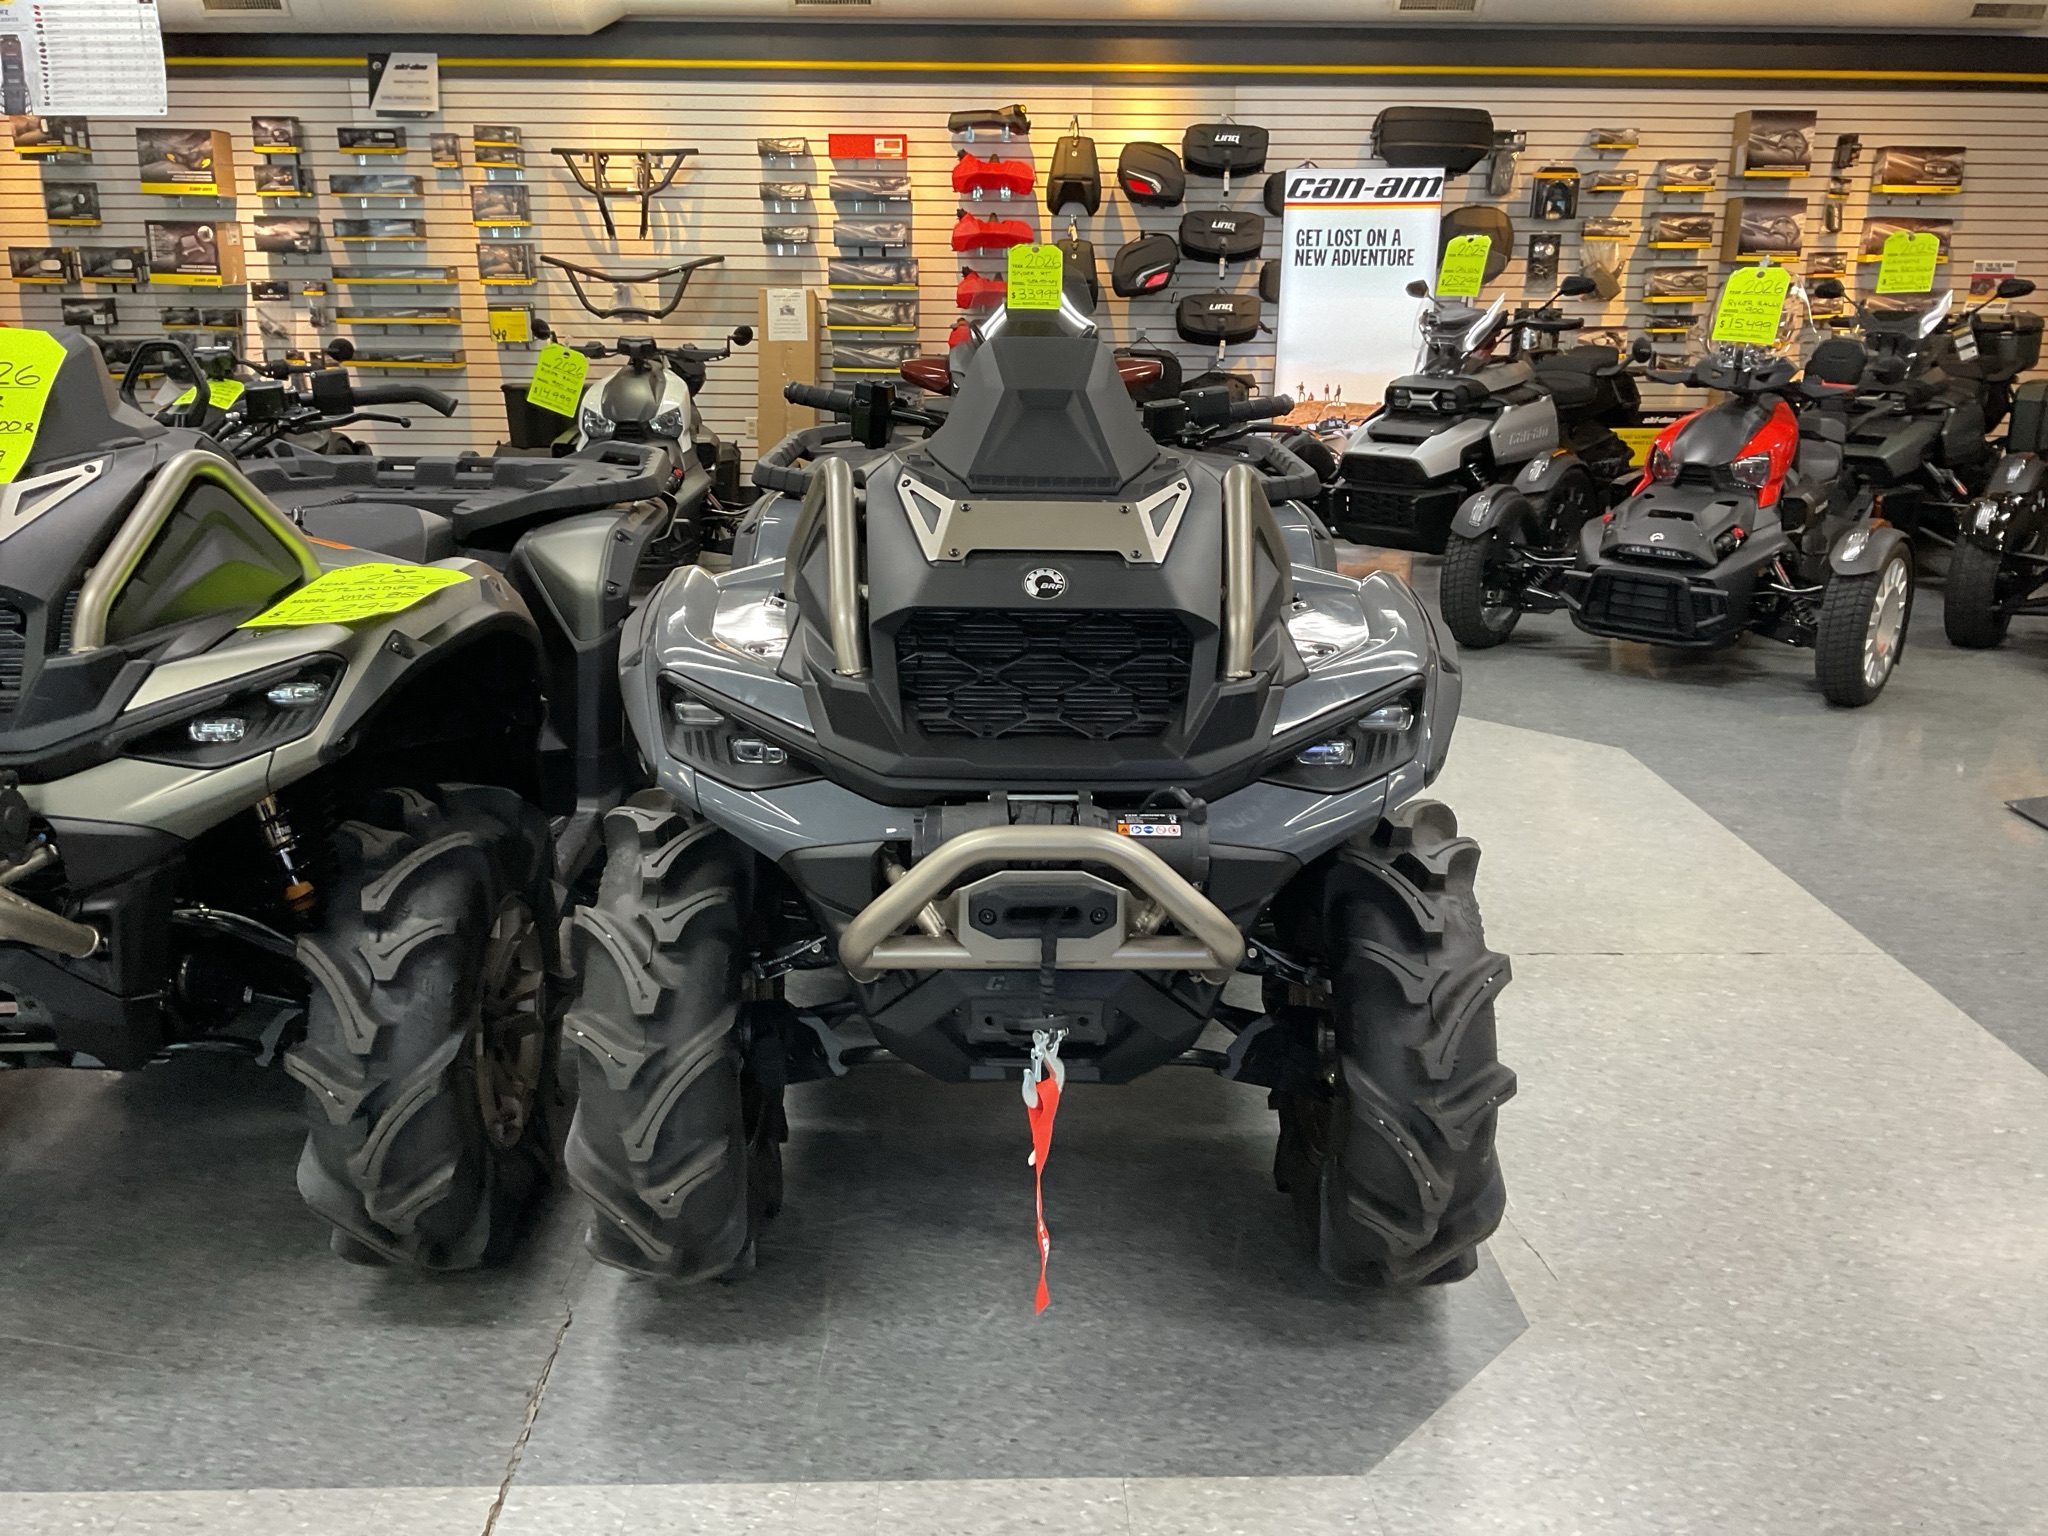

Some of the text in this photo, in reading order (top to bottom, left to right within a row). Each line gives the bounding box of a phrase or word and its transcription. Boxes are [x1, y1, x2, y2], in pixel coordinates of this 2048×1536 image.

[1296, 228, 1402, 247] GET LOST ON A
[1294, 248, 1415, 267] NEW ADVENTURE
[1457, 243, 1488, 257] 2025
[1025, 254, 1061, 269] 2026
[1743, 280, 1784, 295] 2026
[553, 357, 584, 379] 2026
[352, 573, 449, 585] 2026
[1040, 582, 1063, 590] BRP
[306, 585, 420, 594] OUTLANDER
